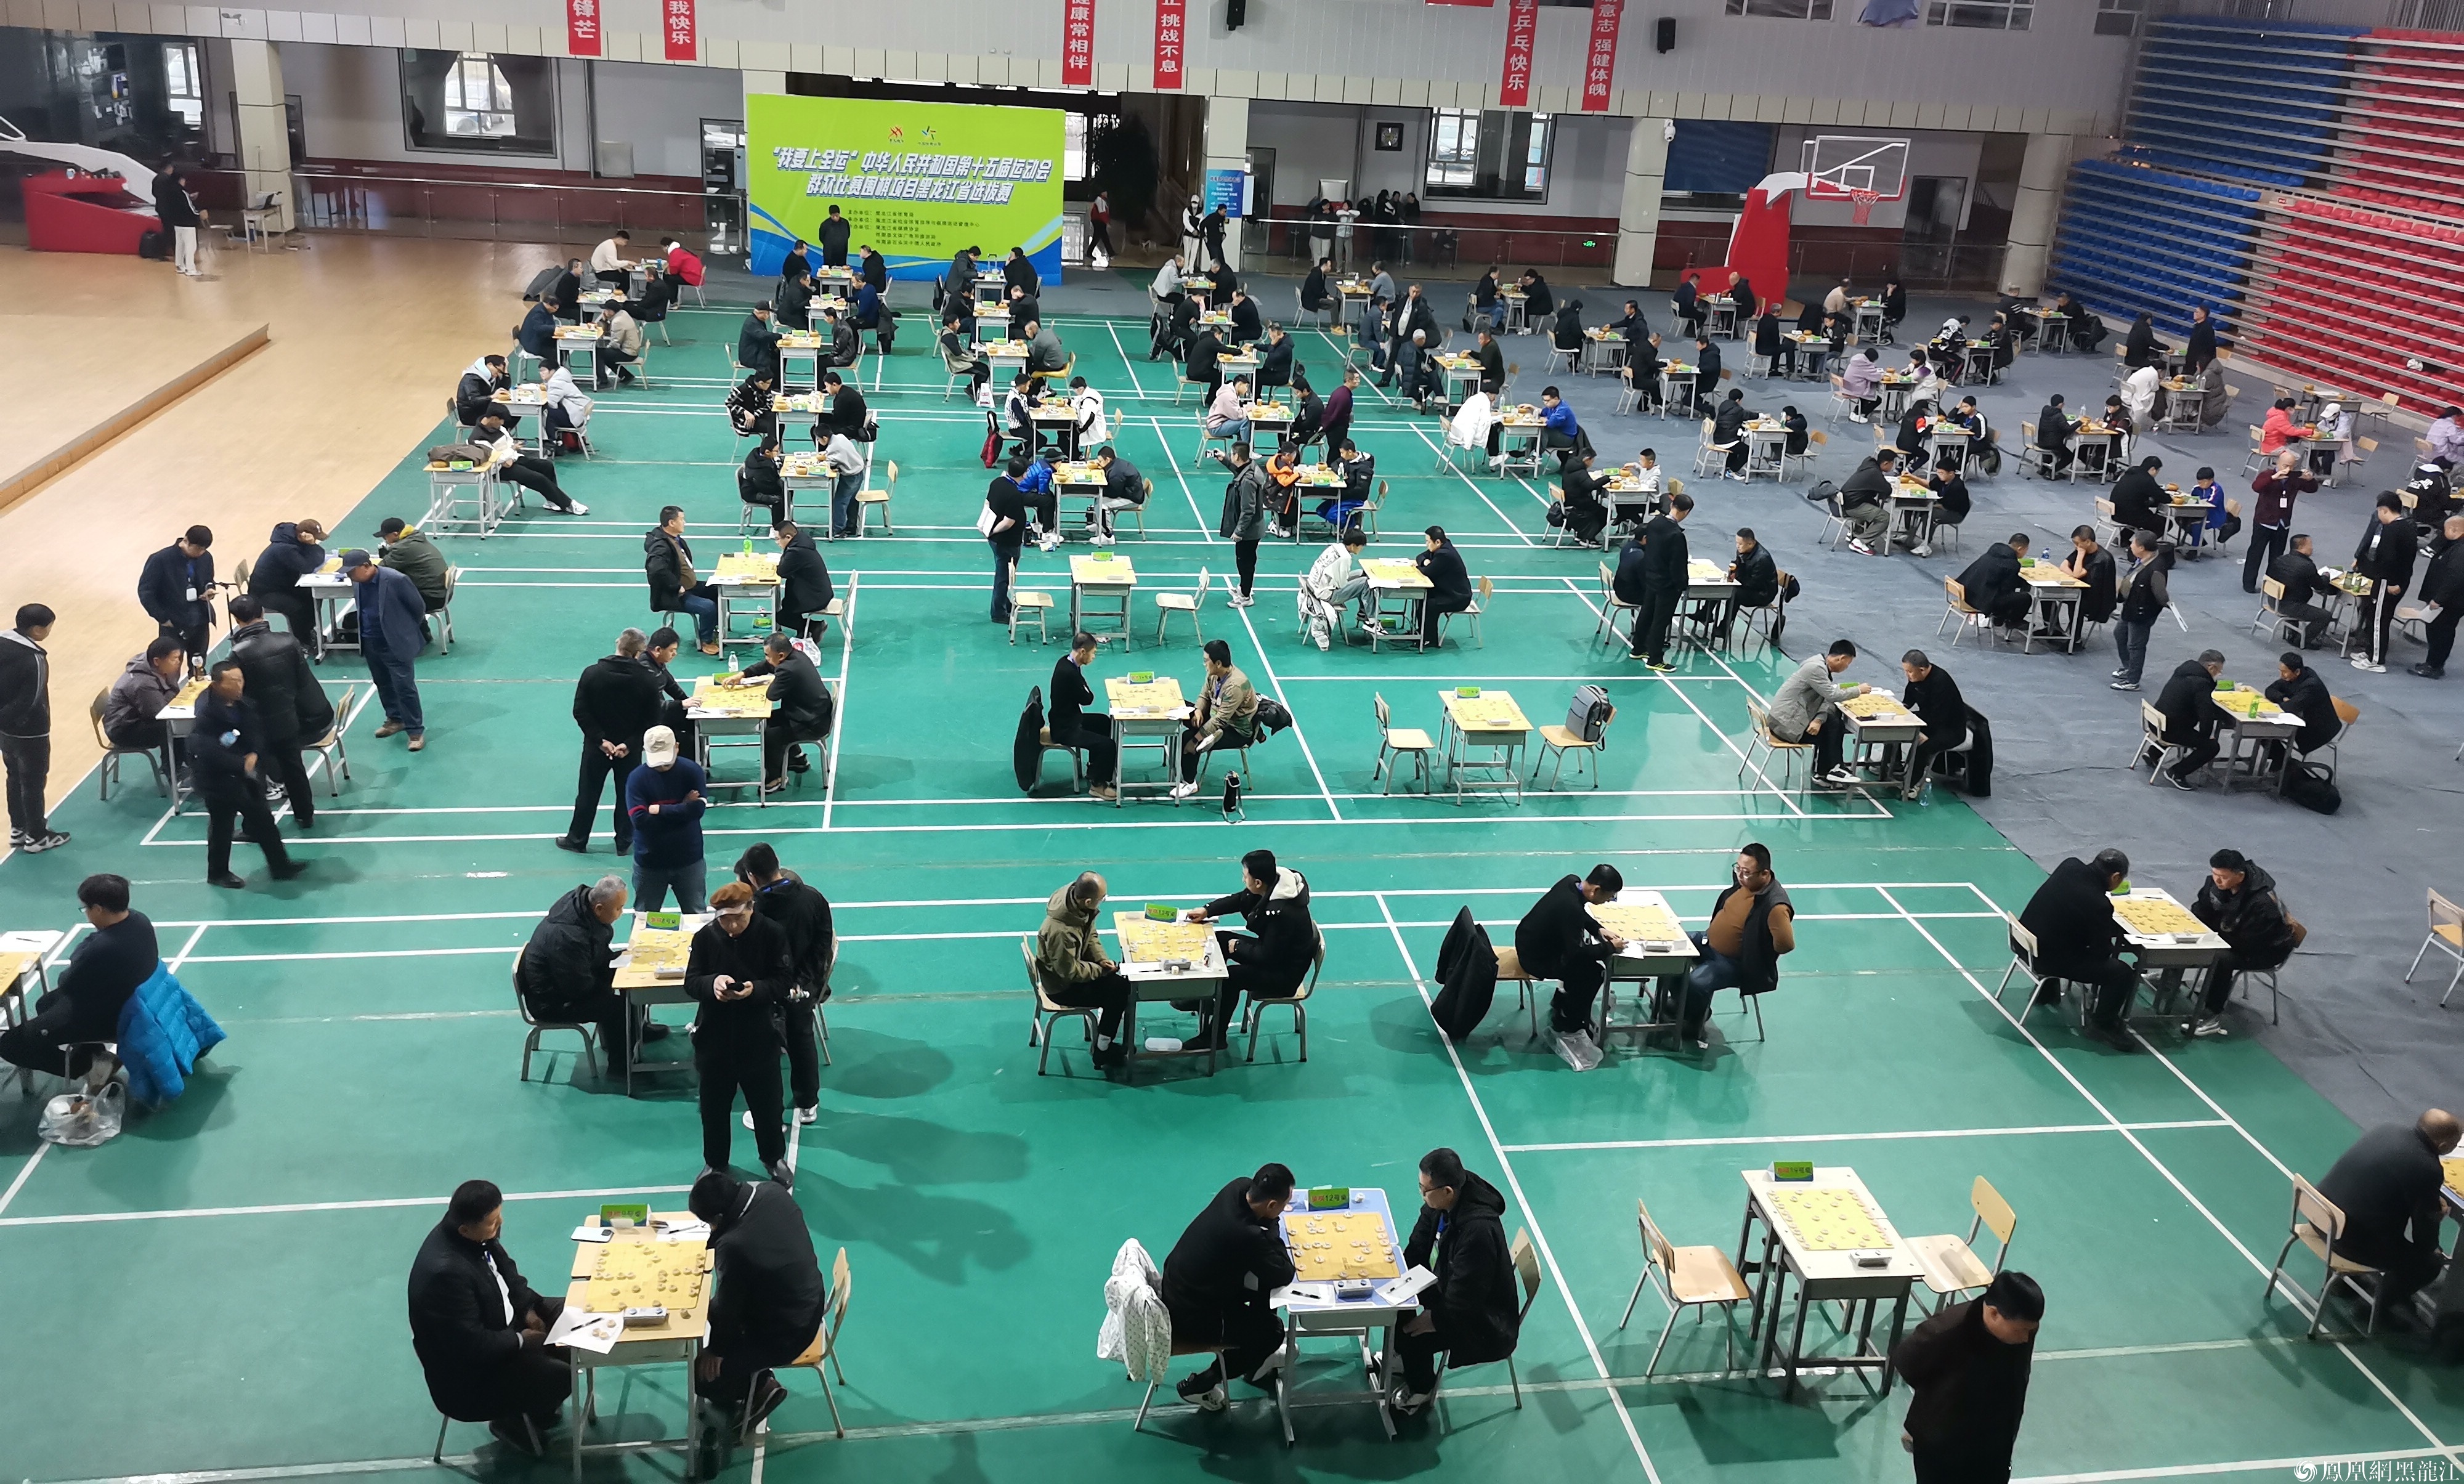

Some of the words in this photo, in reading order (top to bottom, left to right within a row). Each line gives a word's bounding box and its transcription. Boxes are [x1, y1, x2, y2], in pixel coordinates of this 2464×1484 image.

[669, 0, 691, 44] 我快乐
[1596, 0, 1617, 32] 意志
[1159, 14, 1181, 72] 挑战不息
[1589, 39, 1611, 96] 强健体魄
[806, 173, 1015, 205] 群众比赛围棋项目黑龙江省选拔赛
